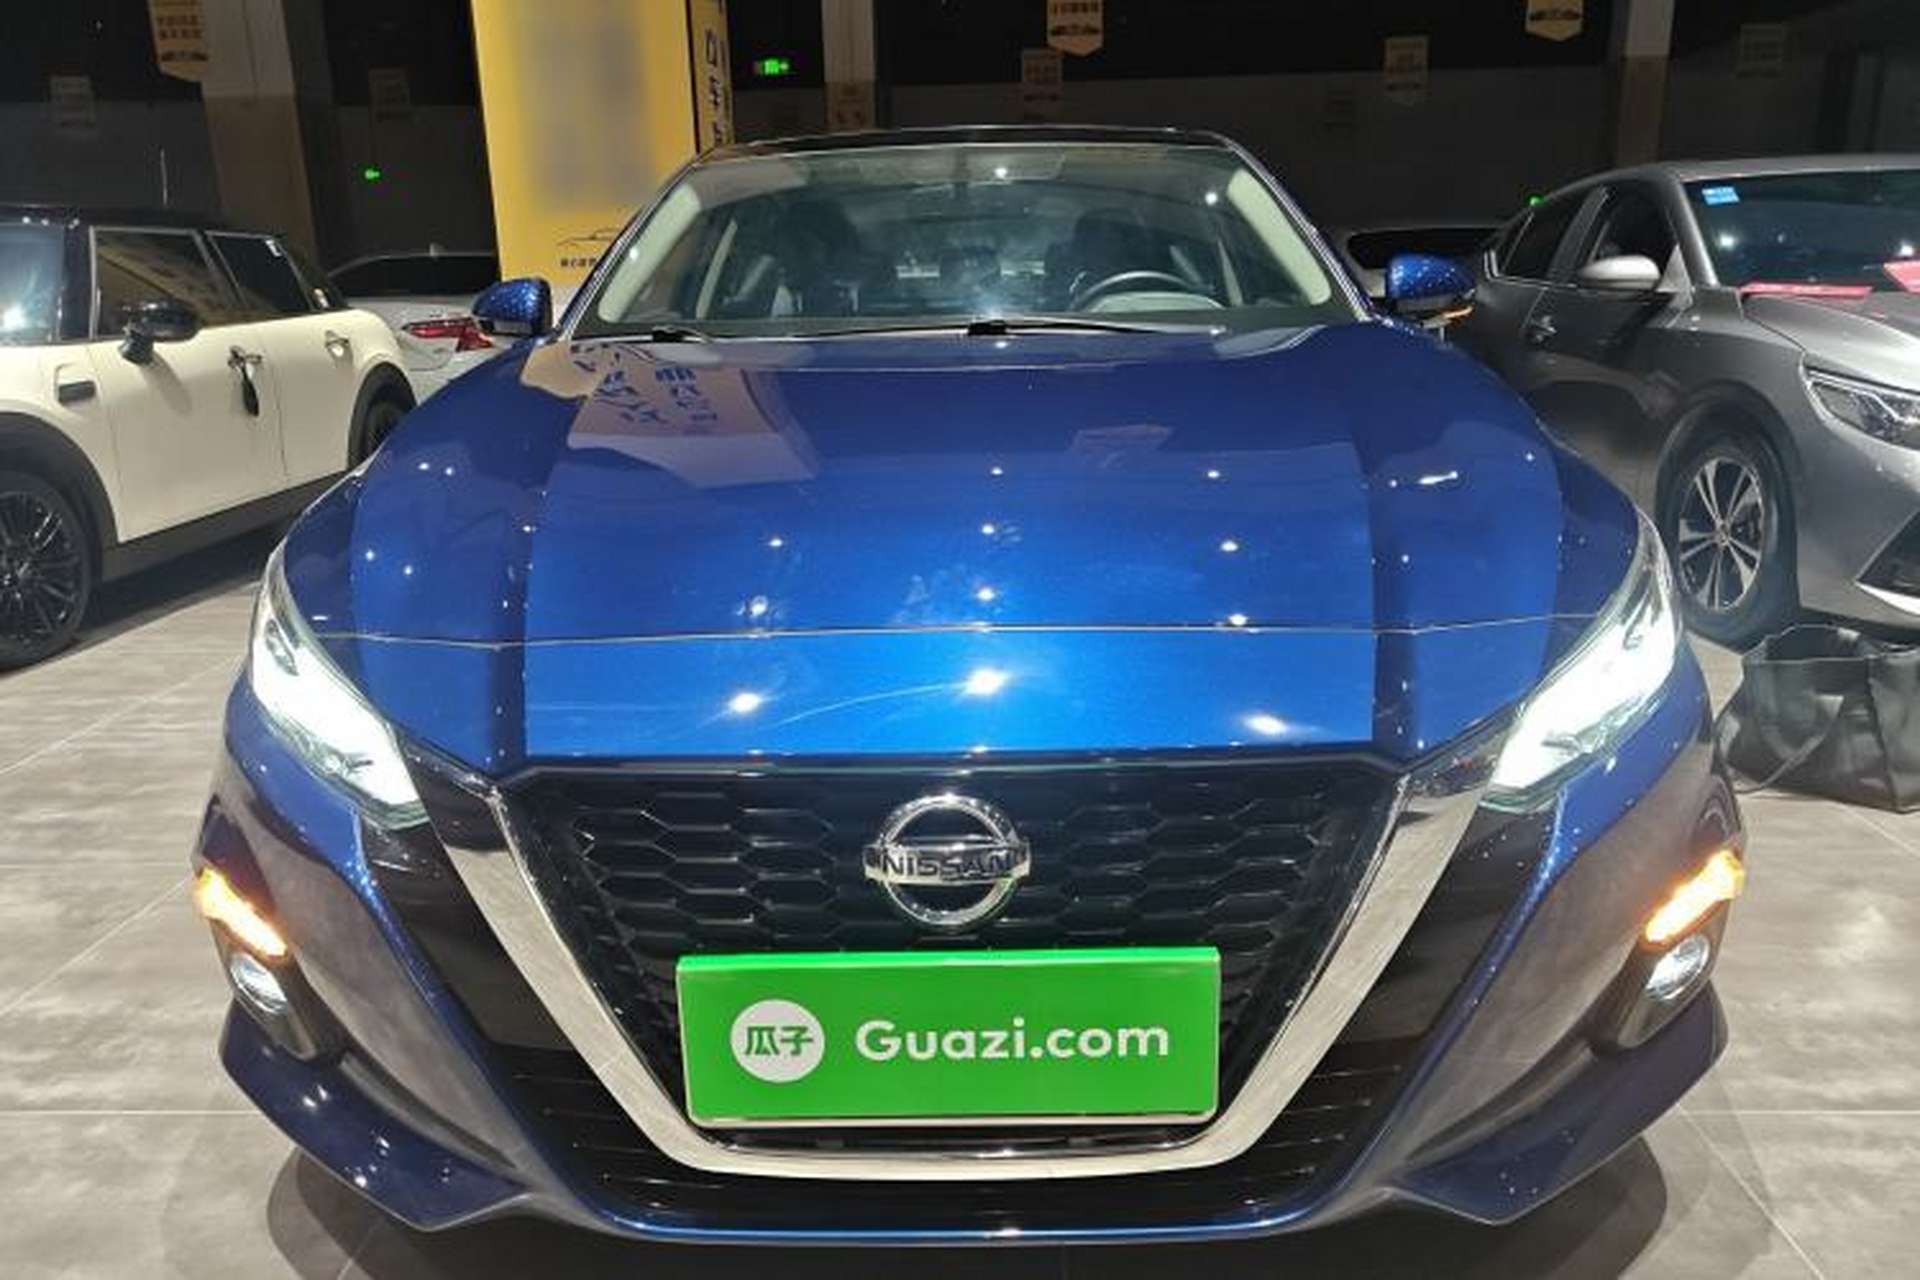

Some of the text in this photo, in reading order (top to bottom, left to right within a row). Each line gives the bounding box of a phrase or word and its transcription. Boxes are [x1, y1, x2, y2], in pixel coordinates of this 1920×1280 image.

[881, 849, 1011, 879] NISSAN
[745, 1024, 813, 1056] 瓜子
[855, 1017, 1169, 1061] Guazi.com
